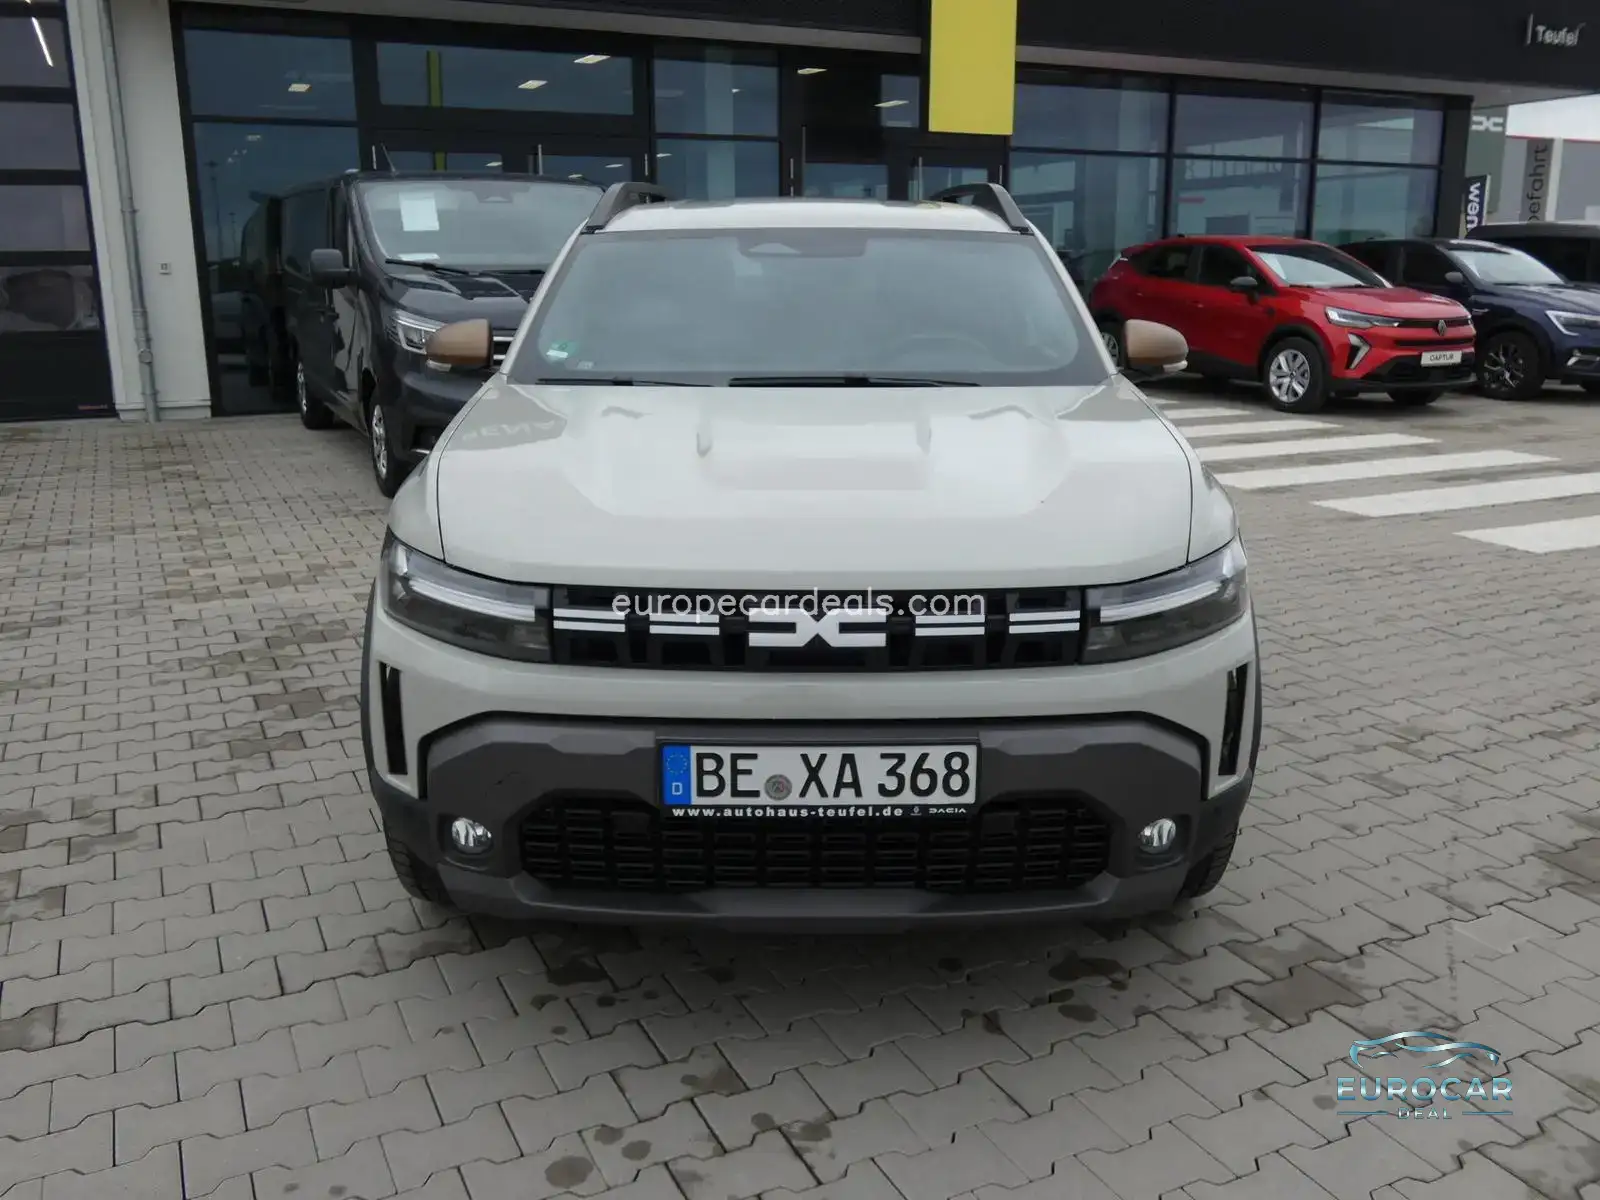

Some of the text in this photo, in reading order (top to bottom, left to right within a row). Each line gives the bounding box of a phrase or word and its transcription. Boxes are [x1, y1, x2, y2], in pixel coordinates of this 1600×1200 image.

[1535, 25, 1580, 46] Teufel
[695, 751, 970, 798] BE XA 368
[672, 782, 683, 795] D
[672, 806, 903, 818] www.autohaus-teufel.de
